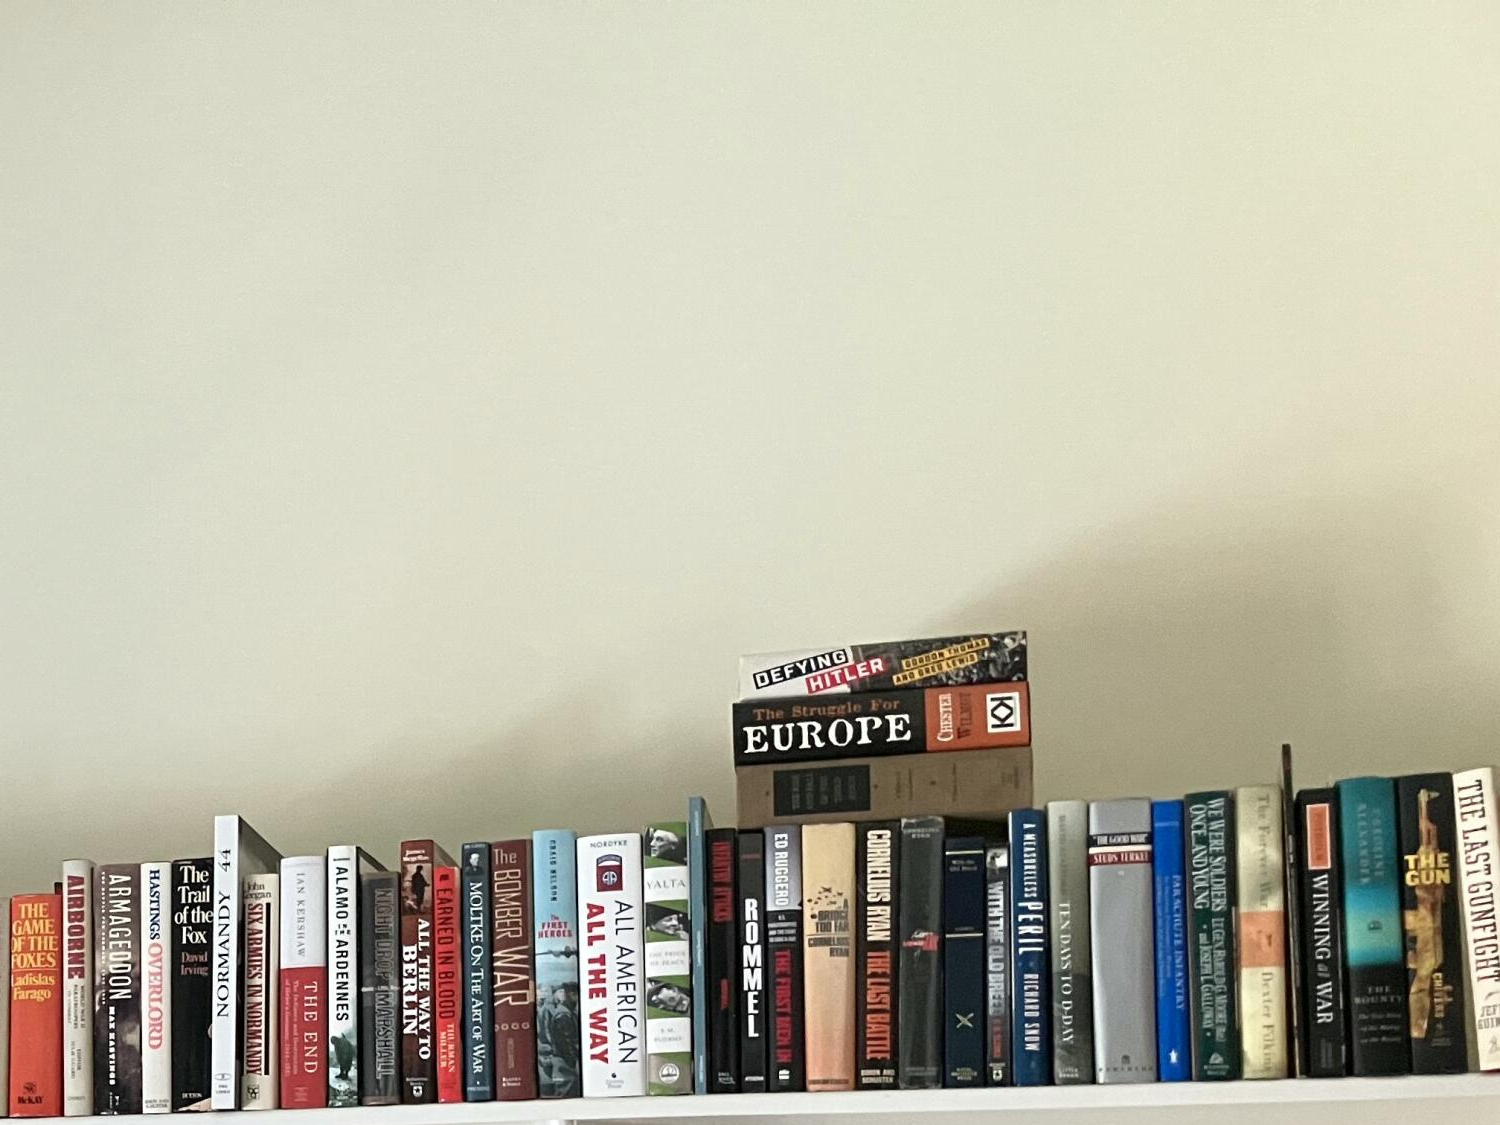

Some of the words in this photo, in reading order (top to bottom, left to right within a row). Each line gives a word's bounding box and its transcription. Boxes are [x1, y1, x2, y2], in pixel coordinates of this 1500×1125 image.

[755, 650, 846, 688] DEFYING
[905, 652, 945, 670] GORDON
[947, 640, 988, 657] THOMAS
[808, 657, 884, 693] HITLER
[753, 708, 785, 721] The
[791, 702, 862, 719] Struggle
[870, 699, 901, 711] For
[742, 713, 912, 754] EUROPE
[1207, 798, 1225, 817] WE
[1457, 779, 1484, 822] THE
[590, 840, 629, 848] NORDYKE
[774, 833, 788, 849] ED
[1208, 819, 1226, 854] WERE
[1462, 825, 1492, 877] LAST
[179, 865, 209, 884] The
[219, 848, 231, 873] 44
[495, 849, 517, 864] The
[866, 829, 892, 903] CORNELIUS
[1404, 852, 1450, 869] THE
[177, 886, 210, 904] Trail
[296, 872, 305, 894] IAN
[335, 866, 349, 919] ALAMO
[646, 879, 686, 890] YALTA
[774, 851, 788, 907] RUGGERO
[1191, 867, 1210, 909] YOUNG
[1210, 856, 1227, 912] SOLDIERS
[1405, 869, 1450, 886] GUN
[18, 903, 49, 919] THE
[149, 869, 161, 941] HASTINGS
[174, 907, 189, 925] of
[191, 906, 214, 925] the
[247, 903, 263, 925] SIX
[437, 887, 455, 945] EARNED
[469, 881, 483, 943] MOLTKE
[494, 869, 523, 946] BOMBER
[614, 899, 634, 937] ALL
[866, 905, 891, 942] RYAN
[1058, 901, 1071, 929] TEN
[1313, 873, 1331, 961] WINNING
[12, 919, 56, 936] GAME
[28, 935, 59, 951] THE
[66, 875, 85, 980] AIRBORNE
[108, 874, 132, 1000] ARMAGEDDON
[181, 926, 207, 945] Fox
[296, 899, 305, 957] KERSHAW
[418, 918, 430, 952] ALL
[538, 930, 573, 939] HEROES
[586, 902, 606, 947] ALL
[1017, 901, 1044, 955] PERIL
[1466, 881, 1500, 984] GUNFIGHT
[11, 952, 57, 970] FOXES
[181, 952, 208, 963] David
[216, 890, 231, 1018] NORMANDY
[246, 928, 263, 980] ARMIES
[437, 950, 455, 966] IN
[742, 898, 762, 1038] ROMMEL
[866, 950, 891, 975] THE
[1059, 932, 1073, 970] DAYS
[180, 964, 209, 978] Irving
[335, 939, 349, 1022] ARDENNES
[402, 944, 418, 1036] BERLIN
[418, 955, 430, 992] THE
[493, 944, 531, 1007] WAR
[587, 953, 606, 1000] THE
[1060, 973, 1073, 996] TO
[13, 987, 52, 1002] Farago
[147, 942, 164, 1050] OVERLORD
[246, 984, 263, 998] IN
[303, 981, 318, 1022] THE
[437, 971, 455, 1020] BLOOD
[616, 944, 639, 1064] AMERICAN
[866, 978, 891, 1010] LAST
[1023, 973, 1039, 1018] RICHARD
[1316, 980, 1334, 1025] WAR
[418, 994, 431, 1035] WAY
[1061, 999, 1075, 1044] D-DAY
[245, 1001, 263, 1077] NORMANDY
[303, 1031, 318, 1074] END
[418, 1037, 431, 1060] TO
[439, 1031, 447, 1069] MILLER
[446, 1023, 455, 1073] THURMAN
[588, 1007, 609, 1065] WAY
[866, 1013, 891, 1061] BATTLE
[1024, 1022, 1040, 1051] SNOW
[473, 1043, 487, 1074] WAR
